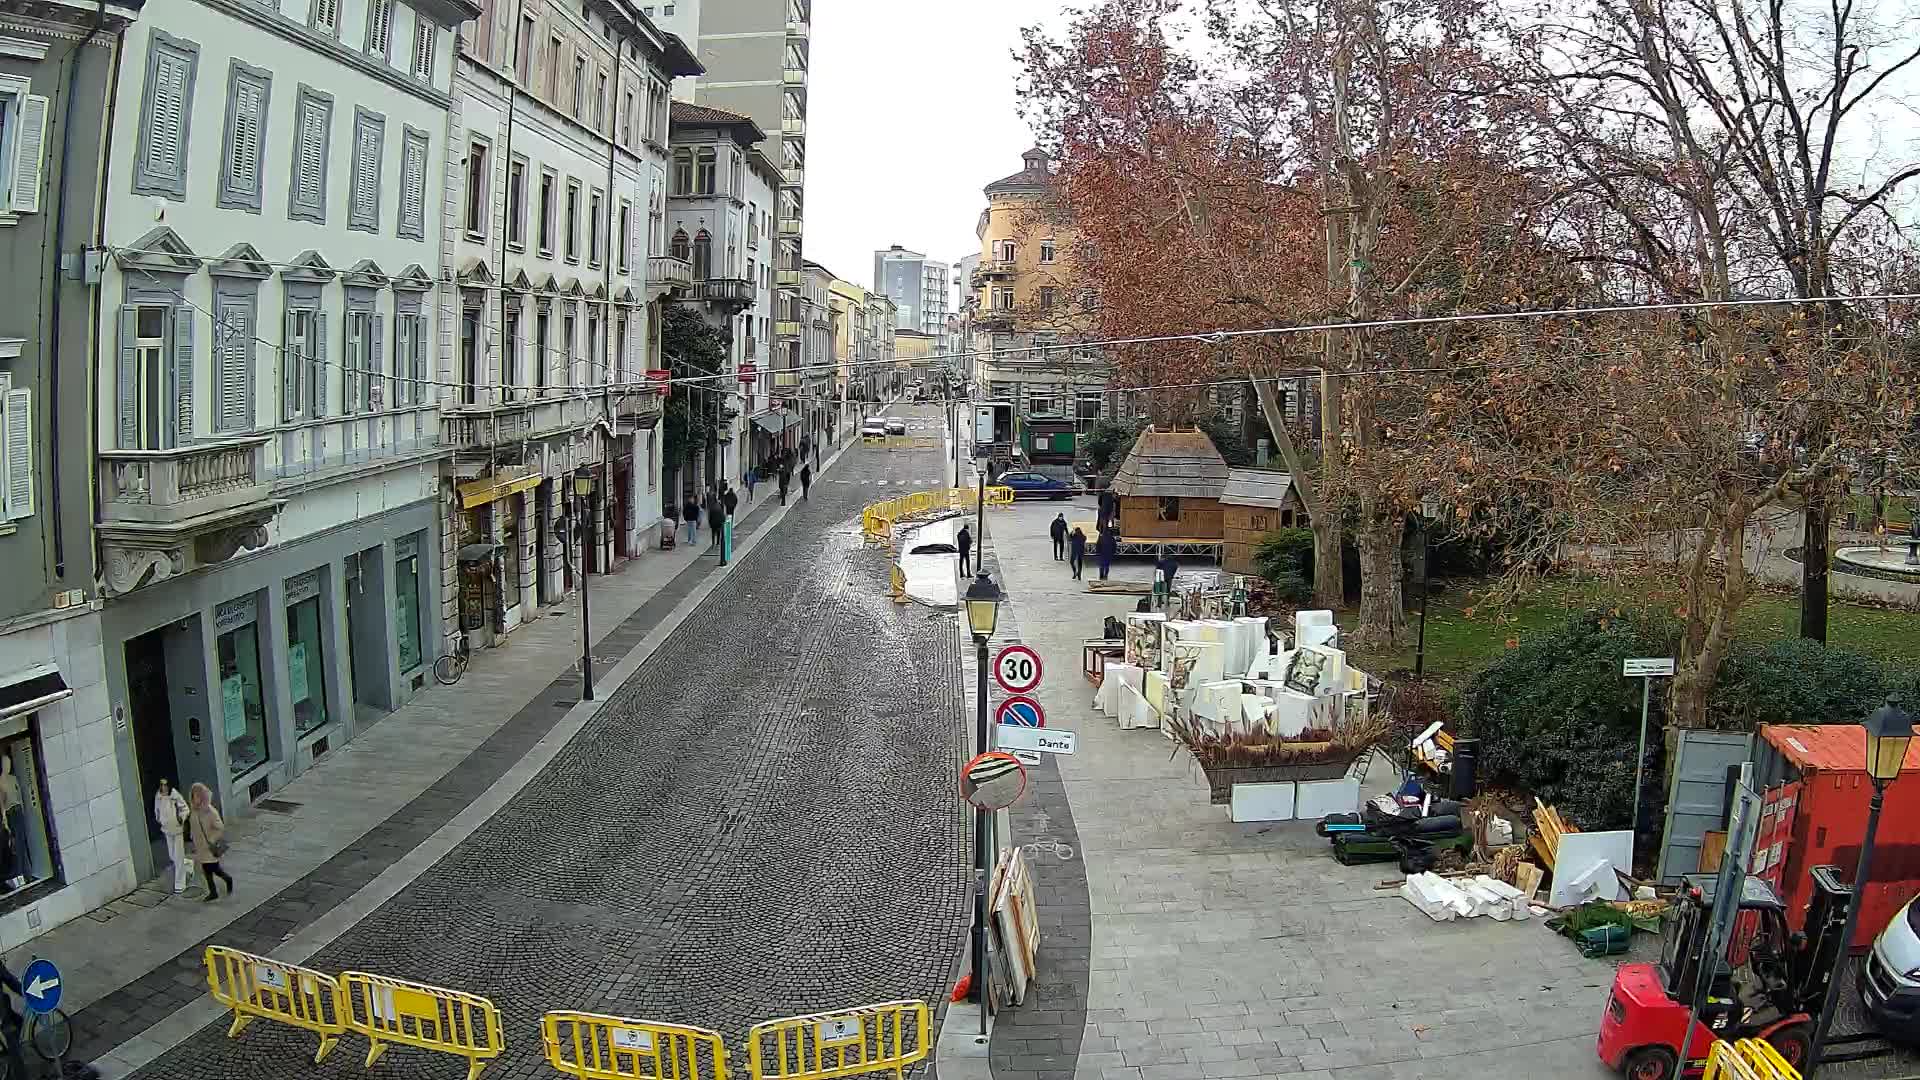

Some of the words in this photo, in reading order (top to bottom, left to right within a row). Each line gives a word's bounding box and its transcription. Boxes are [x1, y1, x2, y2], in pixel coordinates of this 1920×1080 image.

[1005, 658, 1032, 681] 30
[1038, 738, 1070, 750] Dante
[1711, 1018, 1728, 1030] 25
